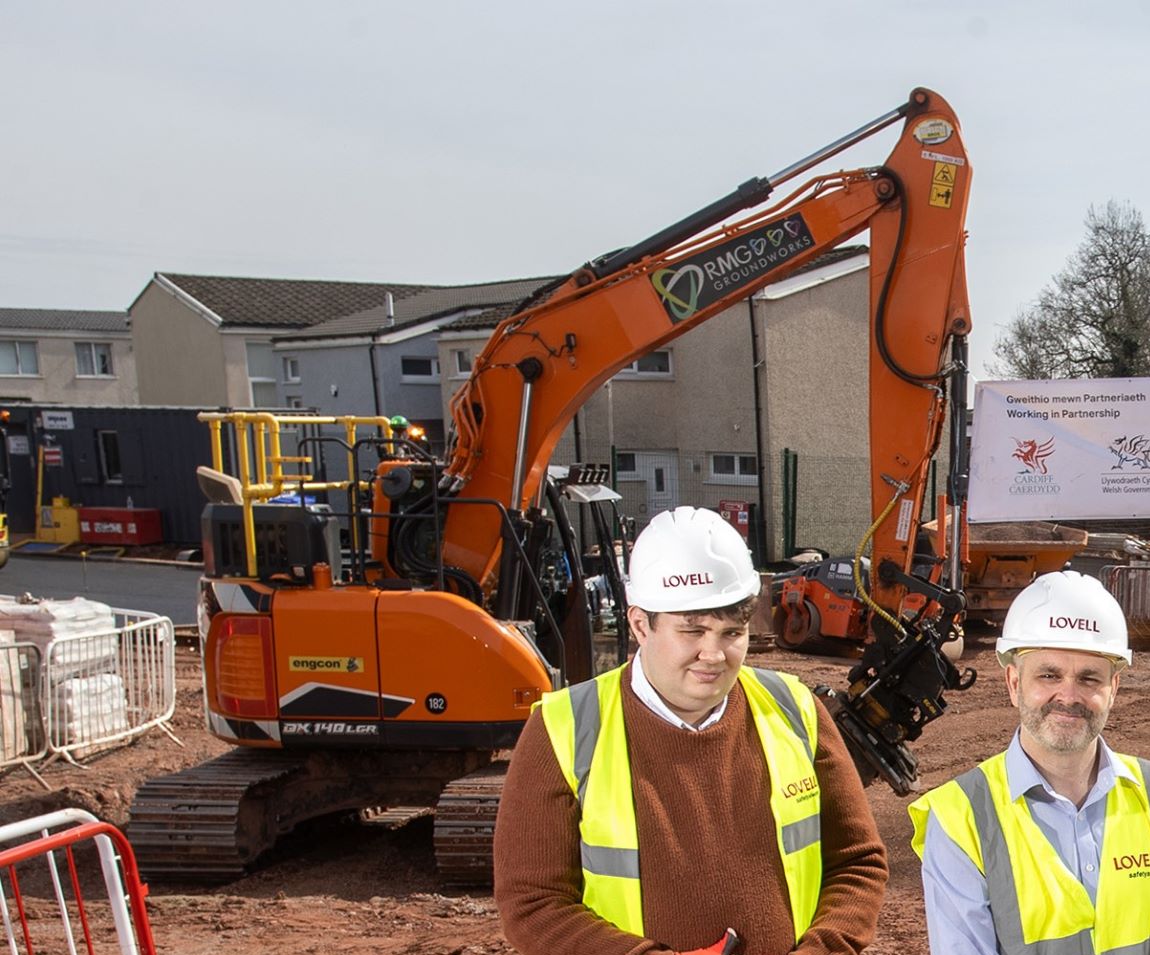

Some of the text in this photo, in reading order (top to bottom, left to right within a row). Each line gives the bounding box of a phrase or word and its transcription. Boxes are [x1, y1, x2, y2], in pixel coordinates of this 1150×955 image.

[704, 245, 752, 280] RMG
[714, 236, 811, 290] GROUNDWORKS
[1006, 395, 1050, 404] Gweithio
[1083, 393, 1146, 403] Partneriaeth
[1006, 409, 1121, 420] Working in Partnership
[663, 572, 714, 588] LOVELL
[1049, 616, 1100, 633] LOVELL
[292, 658, 341, 670] engcon
[428, 698, 445, 710] 182
